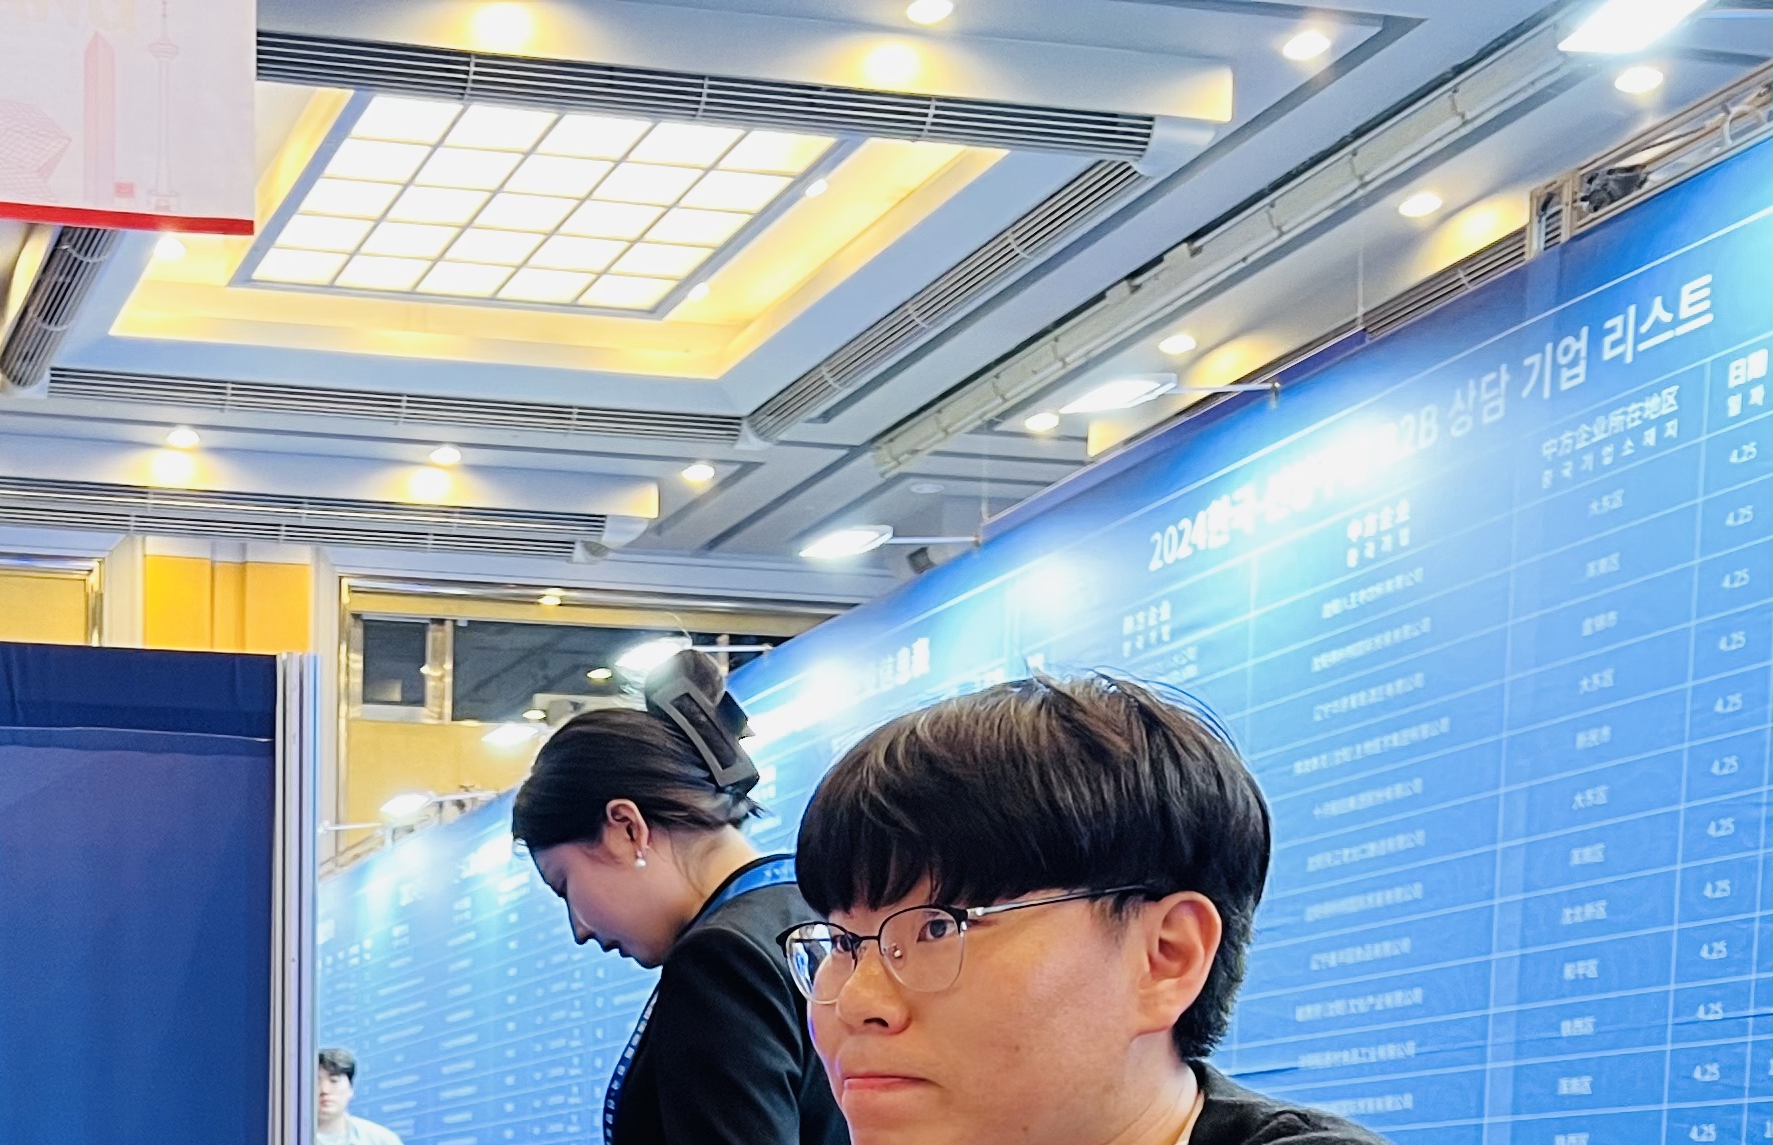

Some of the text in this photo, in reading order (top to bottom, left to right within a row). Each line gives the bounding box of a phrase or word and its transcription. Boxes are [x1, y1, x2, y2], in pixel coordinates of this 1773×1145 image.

[1446, 365, 1512, 441] 상담
[1520, 326, 1590, 400] 기업
[1602, 273, 1714, 364] 리스트
[1700, 941, 1727, 959] 4.25
